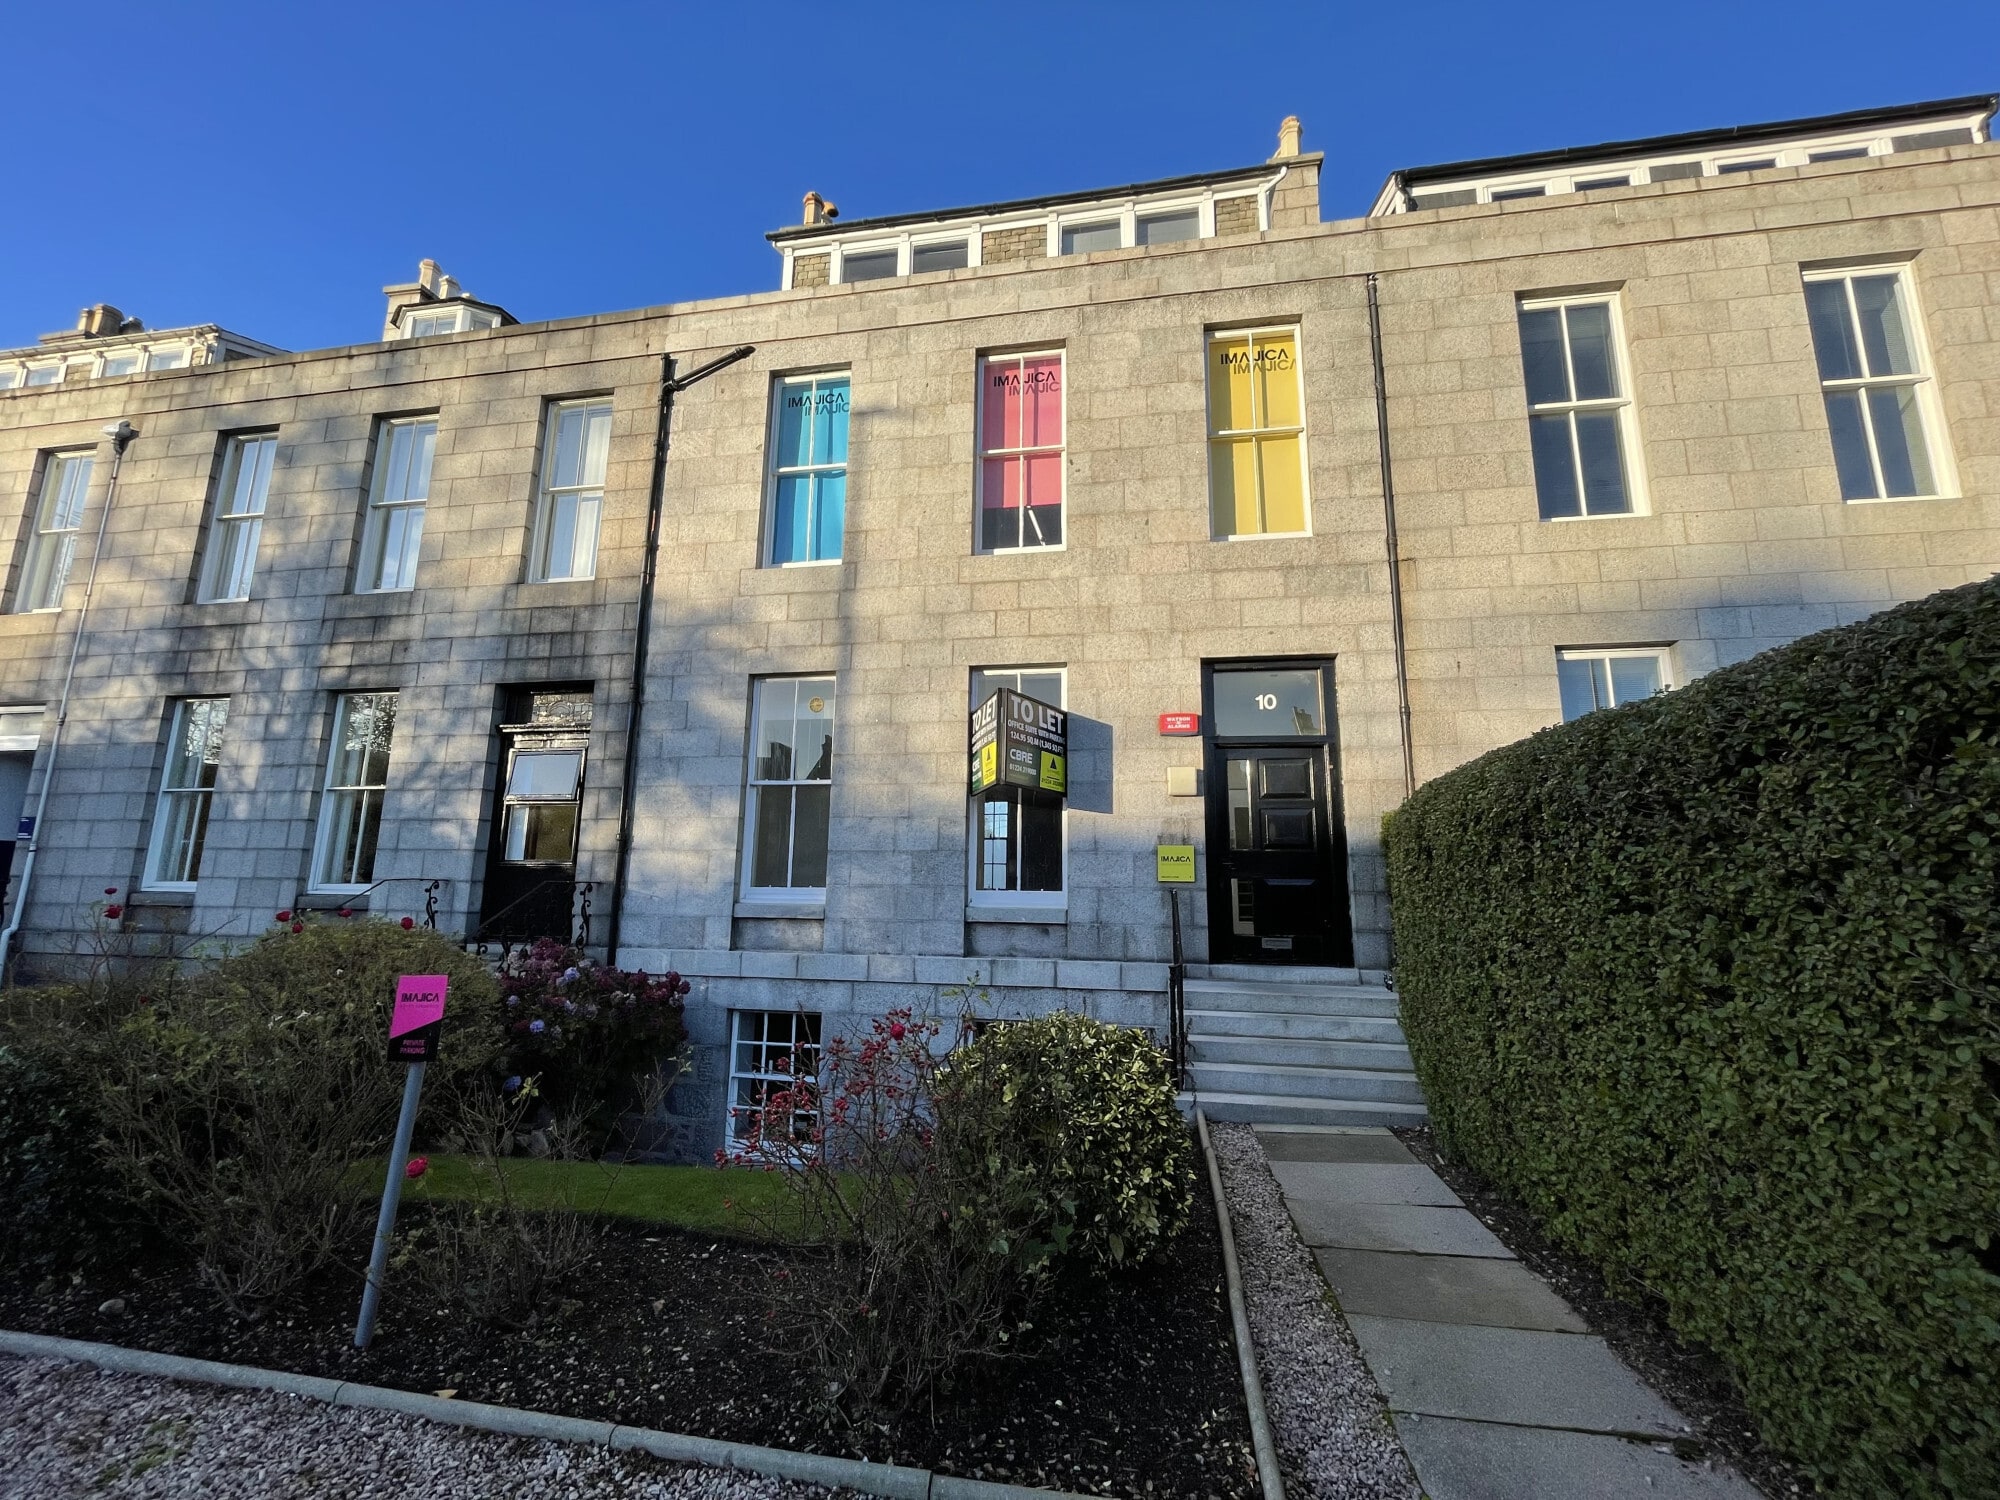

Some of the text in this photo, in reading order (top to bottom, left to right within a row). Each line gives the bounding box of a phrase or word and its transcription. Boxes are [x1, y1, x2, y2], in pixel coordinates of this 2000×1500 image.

[1220, 348, 1288, 365] IMAJICA
[993, 370, 1056, 387] IMAJICA
[788, 392, 845, 408] IMAJICA
[1254, 693, 1277, 710] 10
[972, 708, 982, 735] TO
[981, 693, 997, 727] LET
[1010, 694, 1064, 734] TO LET
[1007, 719, 1025, 731] OFFICE
[1025, 724, 1038, 736] SUITE
[1009, 748, 1034, 765] CBRE
[1160, 855, 1191, 863] IMAJICA
[401, 992, 440, 1003] IMAJICA
[400, 1047, 426, 1055] PARKING
